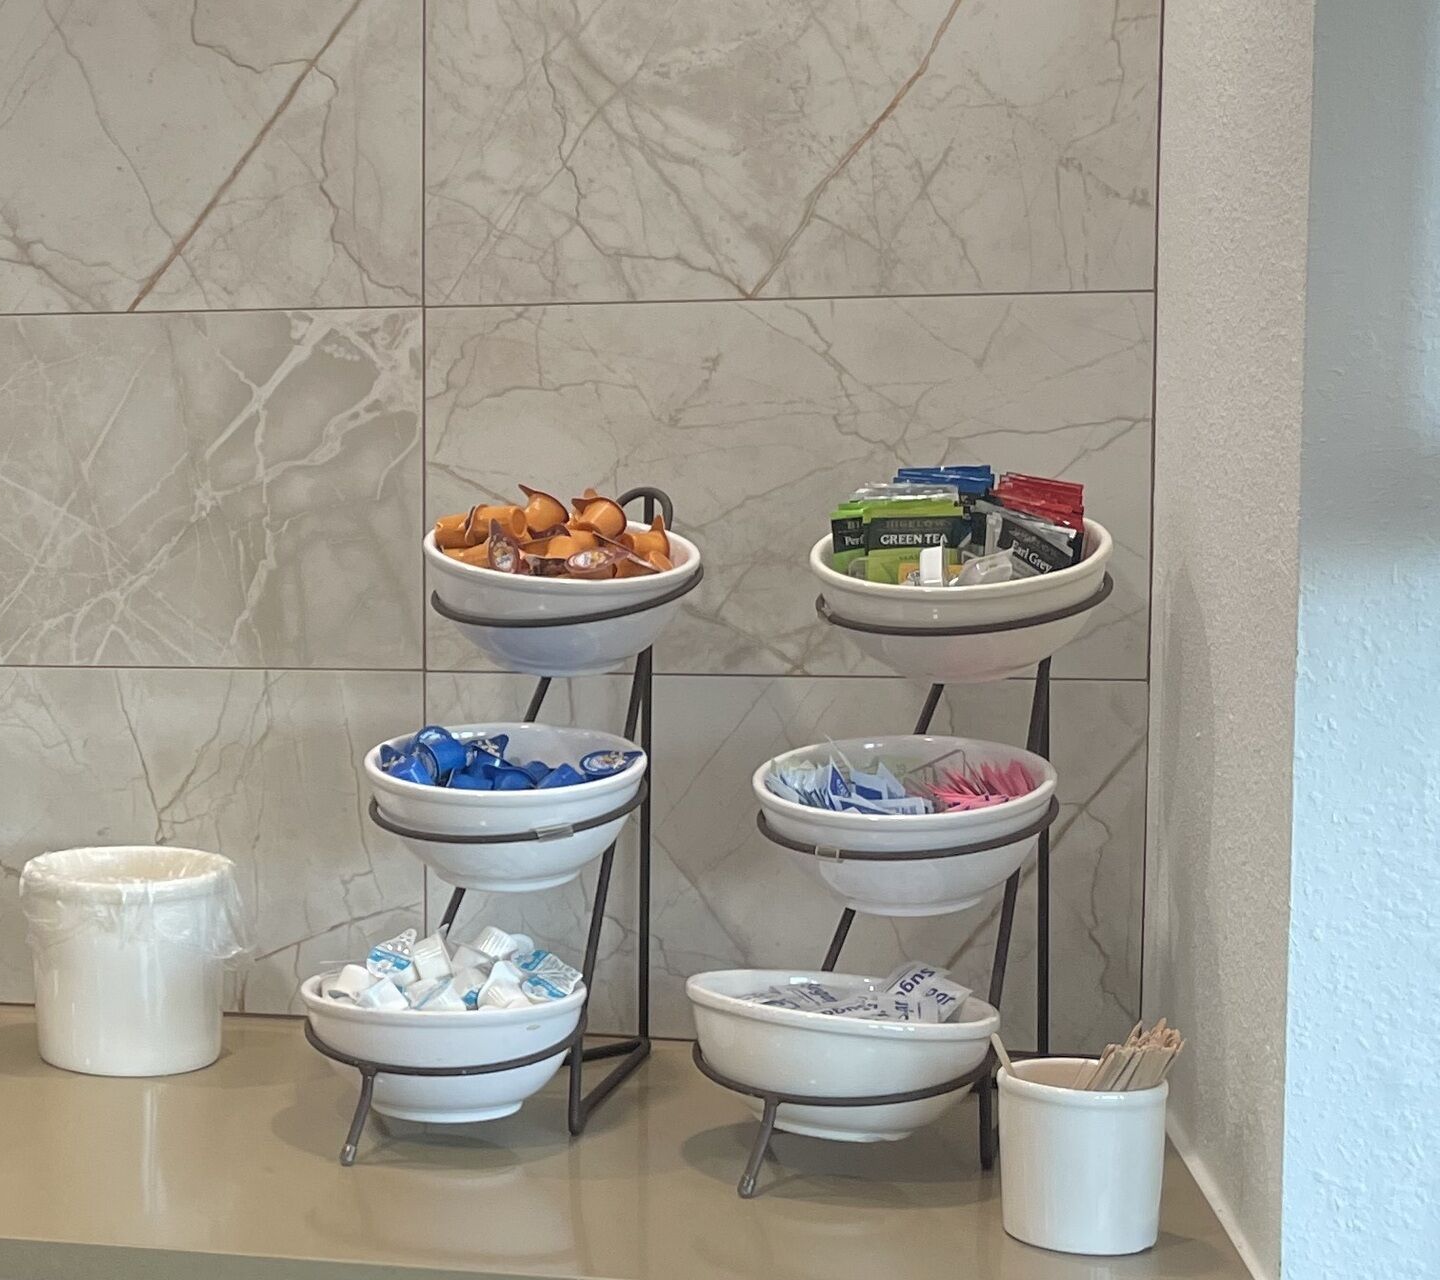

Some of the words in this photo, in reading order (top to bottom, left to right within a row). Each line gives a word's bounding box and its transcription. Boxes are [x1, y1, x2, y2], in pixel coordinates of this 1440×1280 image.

[879, 533, 923, 545] GREEN
[924, 532, 948, 545] TEA
[1013, 539, 1030, 559] Earl
[1029, 552, 1054, 574] Grey
